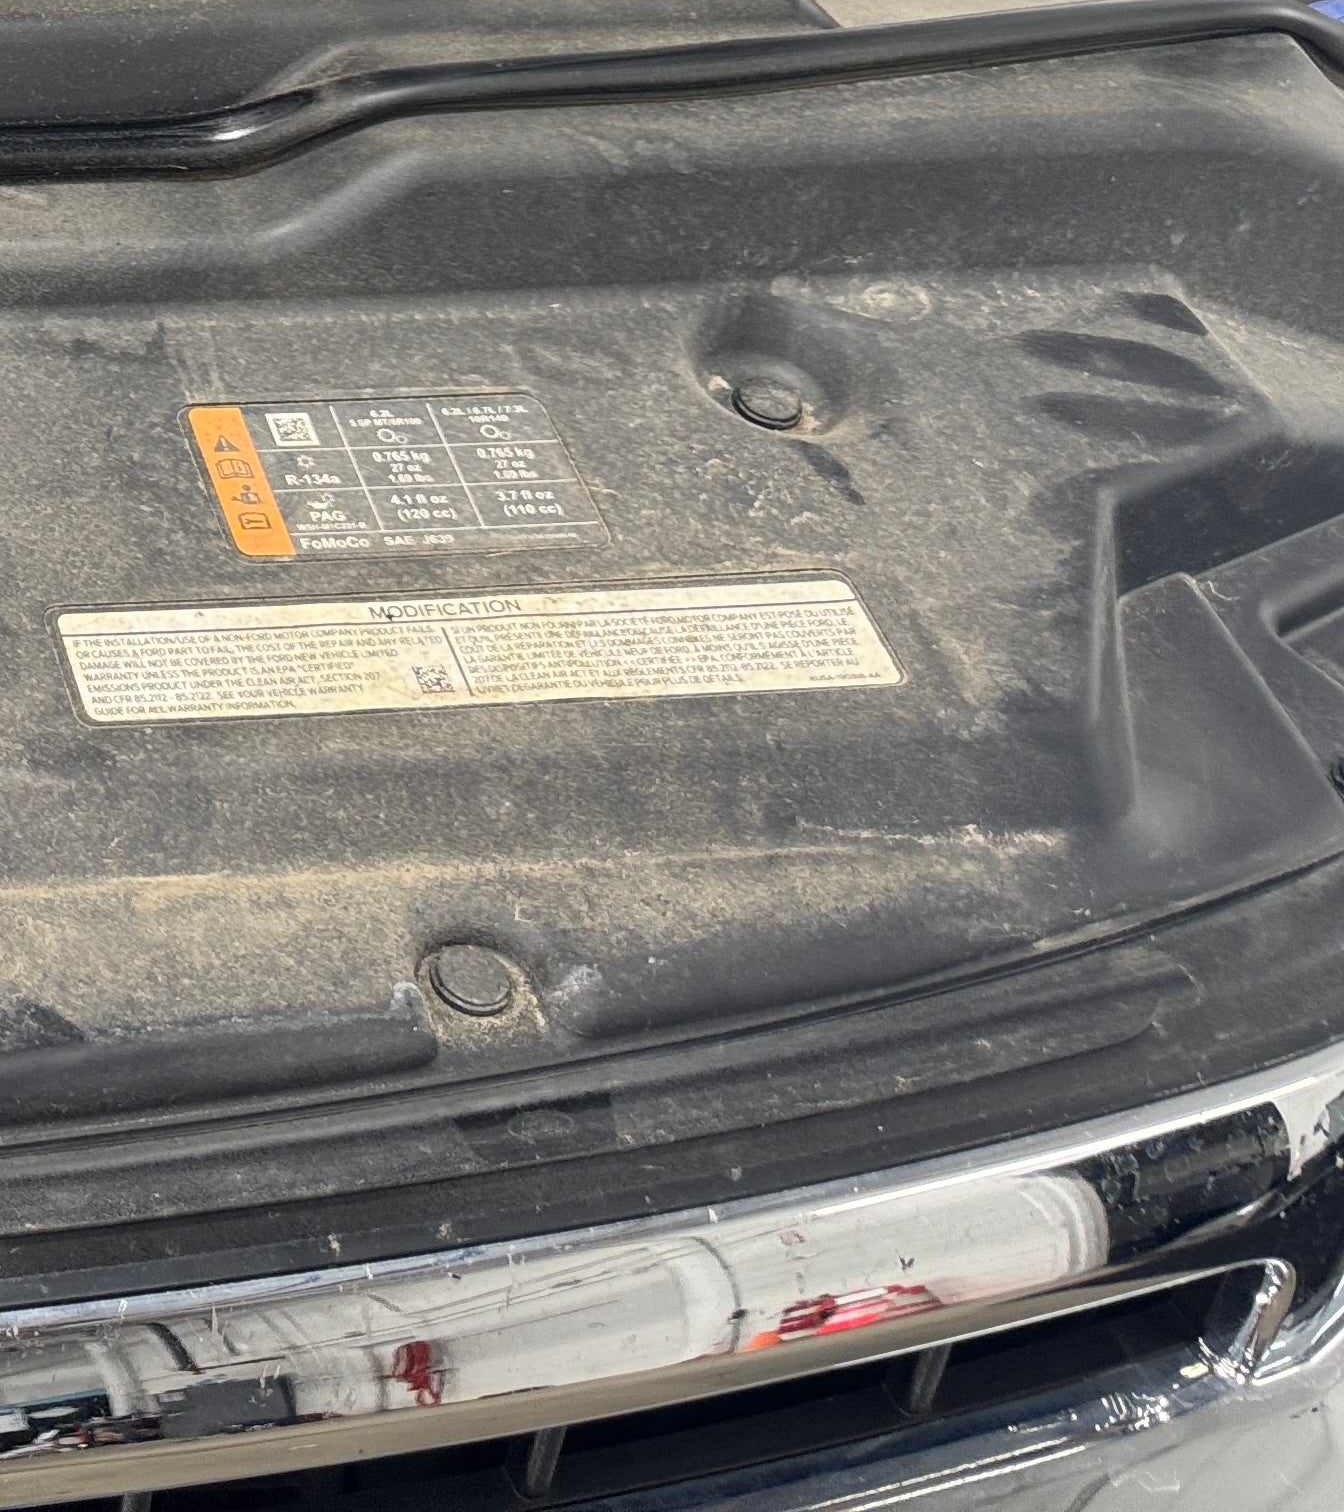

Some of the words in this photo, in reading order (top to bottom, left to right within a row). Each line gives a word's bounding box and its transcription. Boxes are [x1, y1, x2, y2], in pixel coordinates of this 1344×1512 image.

[372, 451, 410, 463] 0.765
[410, 450, 432, 464] kg
[476, 447, 514, 459] 0.765
[514, 446, 536, 460] kg
[390, 463, 404, 473] 27
[406, 463, 422, 472] oz
[284, 473, 343, 486] R-134a
[390, 494, 412, 505] 4.1
[415, 493, 427, 504] fl
[429, 495, 449, 504] oz
[495, 490, 517, 501] 3.7
[520, 489, 533, 500] fl
[535, 490, 555, 500] oz
[309, 510, 347, 522] PAG
[397, 508, 430, 523] (120
[432, 508, 459, 521] cc)
[503, 504, 536, 518] (110
[538, 503, 566, 517] cc)
[299, 536, 370, 550] FoMoCo
[383, 535, 416, 546] SAE
[368, 599, 522, 620] MODIFICATION
[73, 640, 82, 648] IF
[104, 635, 196, 647] INSTALLATION/USE
[213, 634, 221, 642] A
[221, 632, 272, 641] NON-FORD
[273, 630, 309, 639] MOTOR
[310, 628, 358, 637] COMPANY
[359, 626, 405, 635] PRODUCT
[76, 651, 91, 659] OR
[91, 649, 130, 658] CAUSES
[140, 648, 167, 656] FORD
[168, 646, 194, 655] PART
[195, 646, 210, 654] TO
[236, 644, 255, 652] THE
[256, 643, 282, 651] COST
[283, 642, 296, 650] OF
[297, 641, 318, 649] THE
[319, 639, 355, 648] REPAIR
[355, 638, 377, 646] AND
[376, 637, 398, 645] ANY
[398, 635, 443, 644] RELATED
[79, 661, 121, 670] DAMAGE
[122, 660, 147, 668] WILL
[147, 659, 169, 667] NOT
[170, 658, 183, 666] BE
[184, 656, 230, 665] COVERED
[230, 655, 244, 663] BY
[245, 654, 265, 662] THE
[266, 653, 293, 661] FORD
[294, 652, 317, 660] NEW
[319, 650, 359, 659] VEHICLE
[360, 648, 399, 657] LIMITED
[84, 672, 140, 681] WARRANTY
[141, 670, 180, 679] UNLESS
[181, 669, 200, 677] THE
[202, 667, 249, 676] PRODUCT
[249, 666, 260, 674] IS
[276, 665, 296, 673] EPA
[87, 683, 140, 693] EMISSIONS
[141, 681, 189, 690] PRODUCT
[189, 680, 223, 688] UNDER
[224, 679, 244, 687] THE
[245, 677, 277, 686] CLEAN
[283, 676, 299, 684] AIR
[320, 673, 363, 682] SECTION
[363, 672, 383, 680] 207
[91, 696, 112, 704] AND
[113, 695, 132, 703] CFR
[134, 694, 168, 702] 85.2112
[217, 690, 235, 699] SEE
[237, 689, 265, 698] YOUR
[266, 687, 306, 696] VEHICLE
[308, 685, 365, 694] WARRANTY
[95, 707, 124, 716] GUIDE
[126, 706, 146, 714] FOR
[147, 705, 164, 713] ALL
[168, 703, 224, 712] WARRANTY
